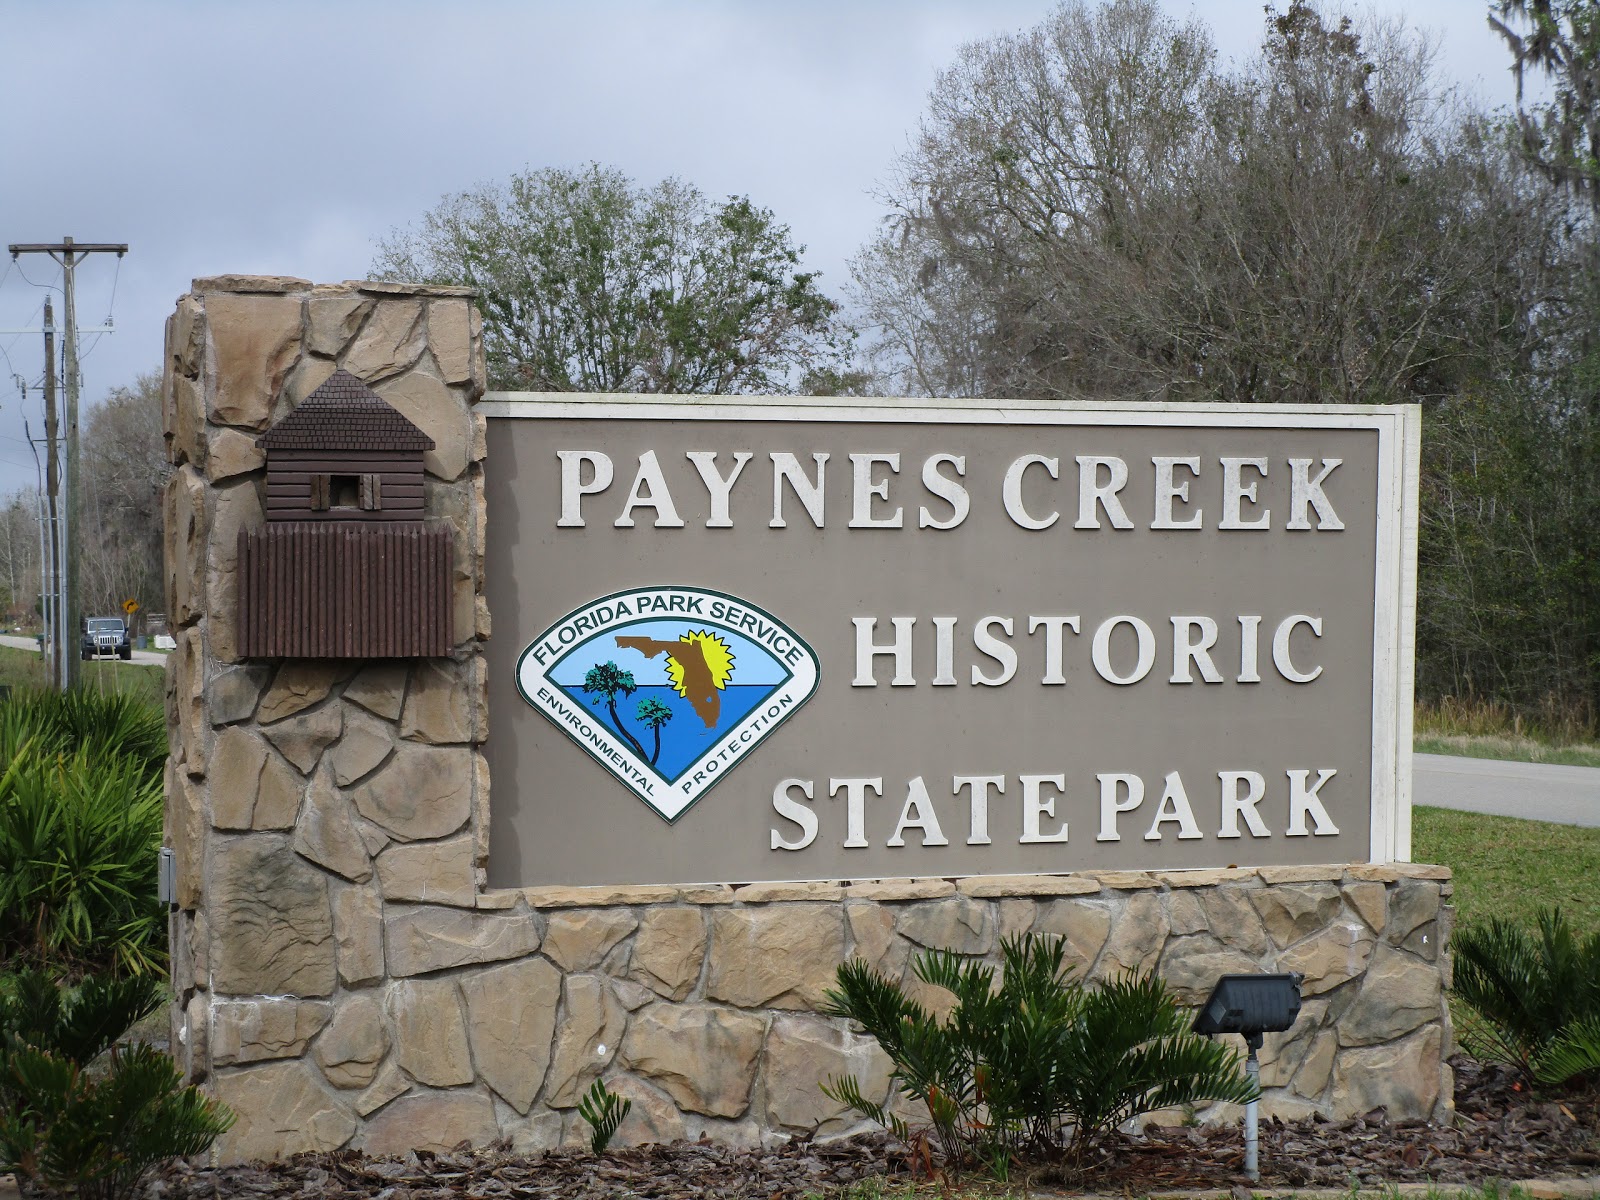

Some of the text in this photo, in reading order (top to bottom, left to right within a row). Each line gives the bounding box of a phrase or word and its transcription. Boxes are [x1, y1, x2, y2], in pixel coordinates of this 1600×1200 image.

[556, 449, 1345, 530] PAYNES CREEK
[532, 594, 804, 667] FLORIDA PARK SERVICE
[851, 614, 1323, 686] HISTORIC
[536, 687, 793, 797] ENVIRONMENTAL PROTECTION
[770, 768, 1340, 850] STATE PARK
